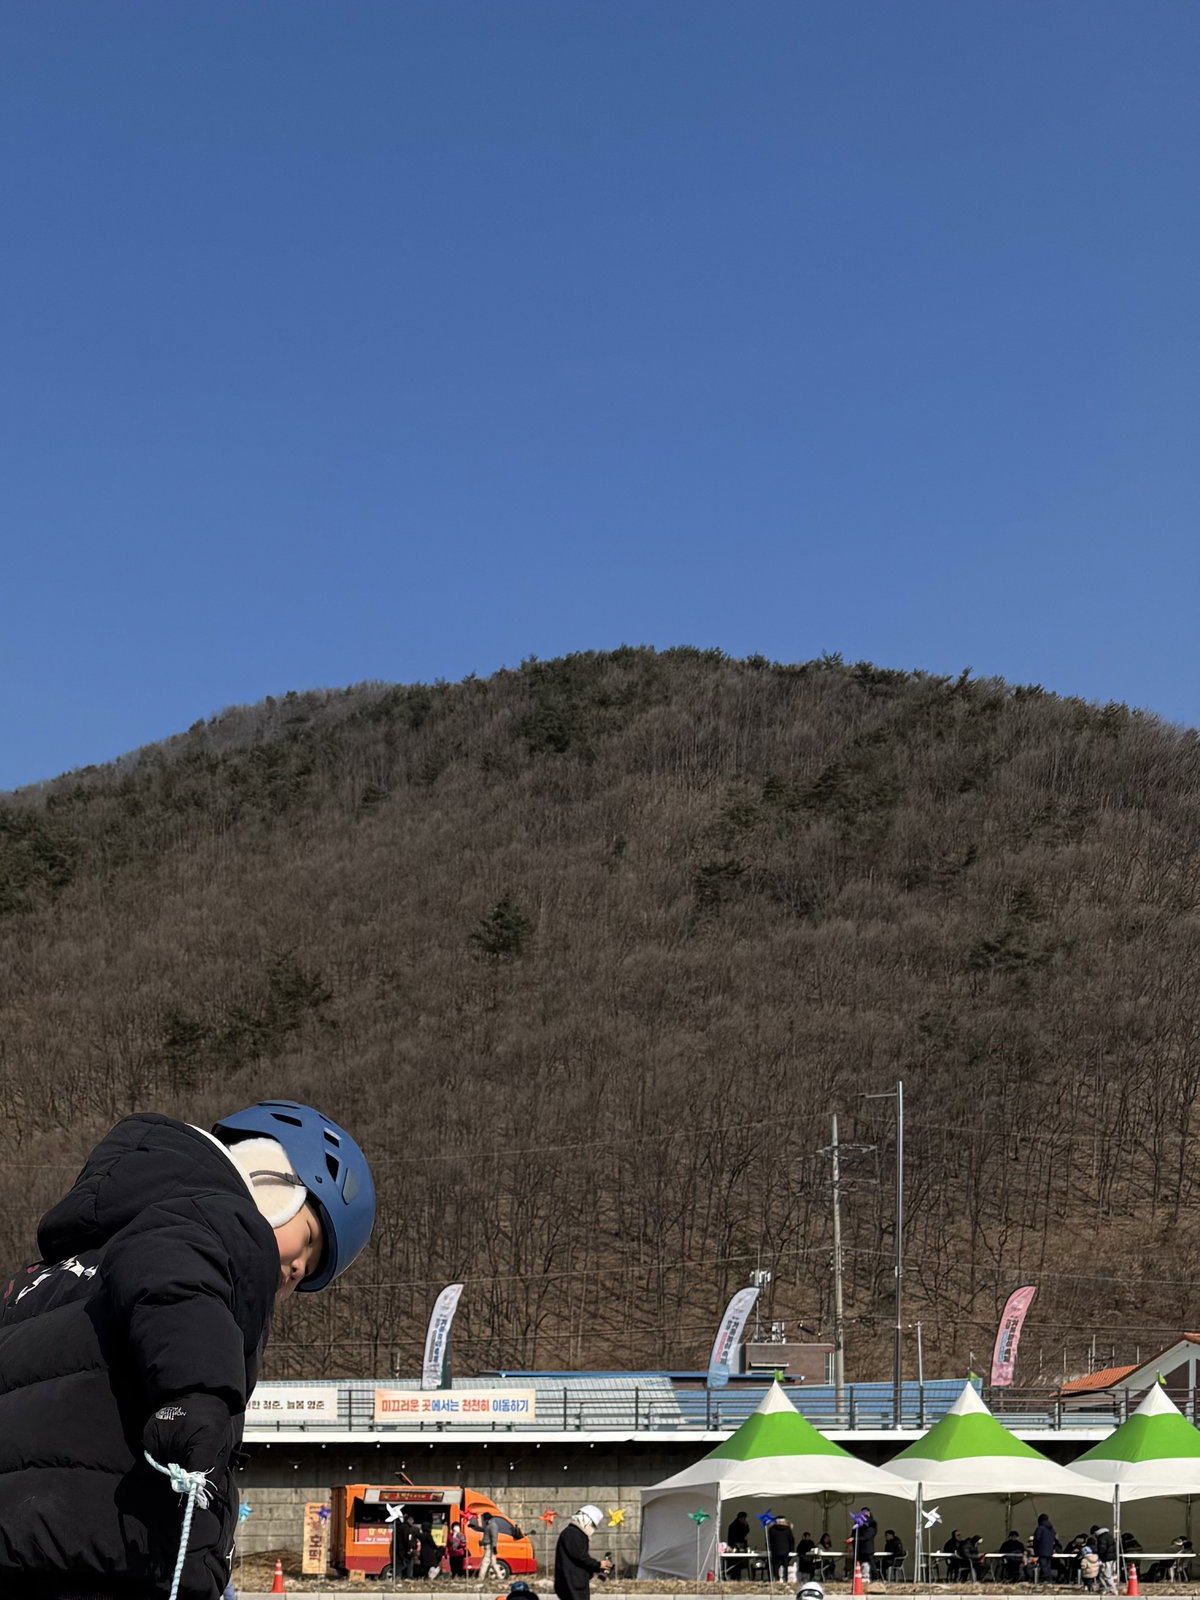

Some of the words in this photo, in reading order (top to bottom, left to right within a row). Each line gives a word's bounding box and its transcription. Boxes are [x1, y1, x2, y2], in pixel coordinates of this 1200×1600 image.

[286, 1400, 304, 1410] 늘봄
[307, 1400, 325, 1410] 영춘
[381, 1399, 419, 1412] 미끄러운
[422, 1399, 459, 1412] 곳에서는
[462, 1399, 490, 1412] 천천히
[492, 1399, 529, 1412] 이동하기
